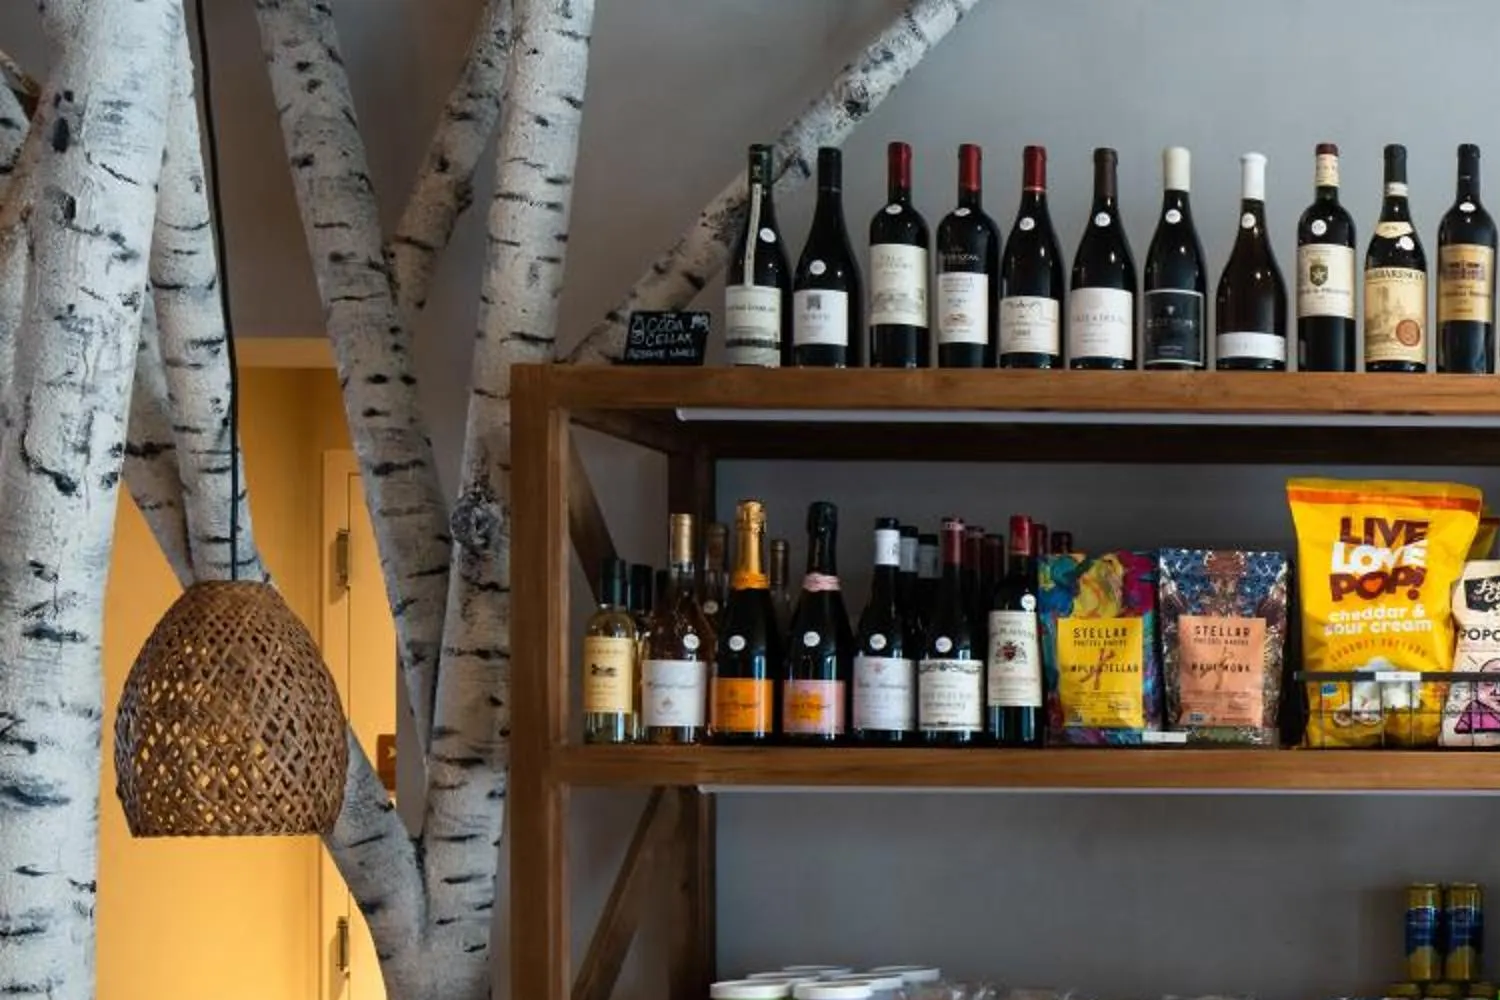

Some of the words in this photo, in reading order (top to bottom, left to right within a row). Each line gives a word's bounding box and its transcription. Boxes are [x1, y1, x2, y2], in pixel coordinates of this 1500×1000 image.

[1340, 517, 1429, 547] LIVE
[1332, 539, 1428, 576] LOVE
[1328, 606, 1408, 622] cheddar
[1412, 604, 1425, 618] &
[1073, 627, 1128, 639] STELLAR
[1194, 625, 1251, 638] STELLAR
[1370, 618, 1433, 633] cream
